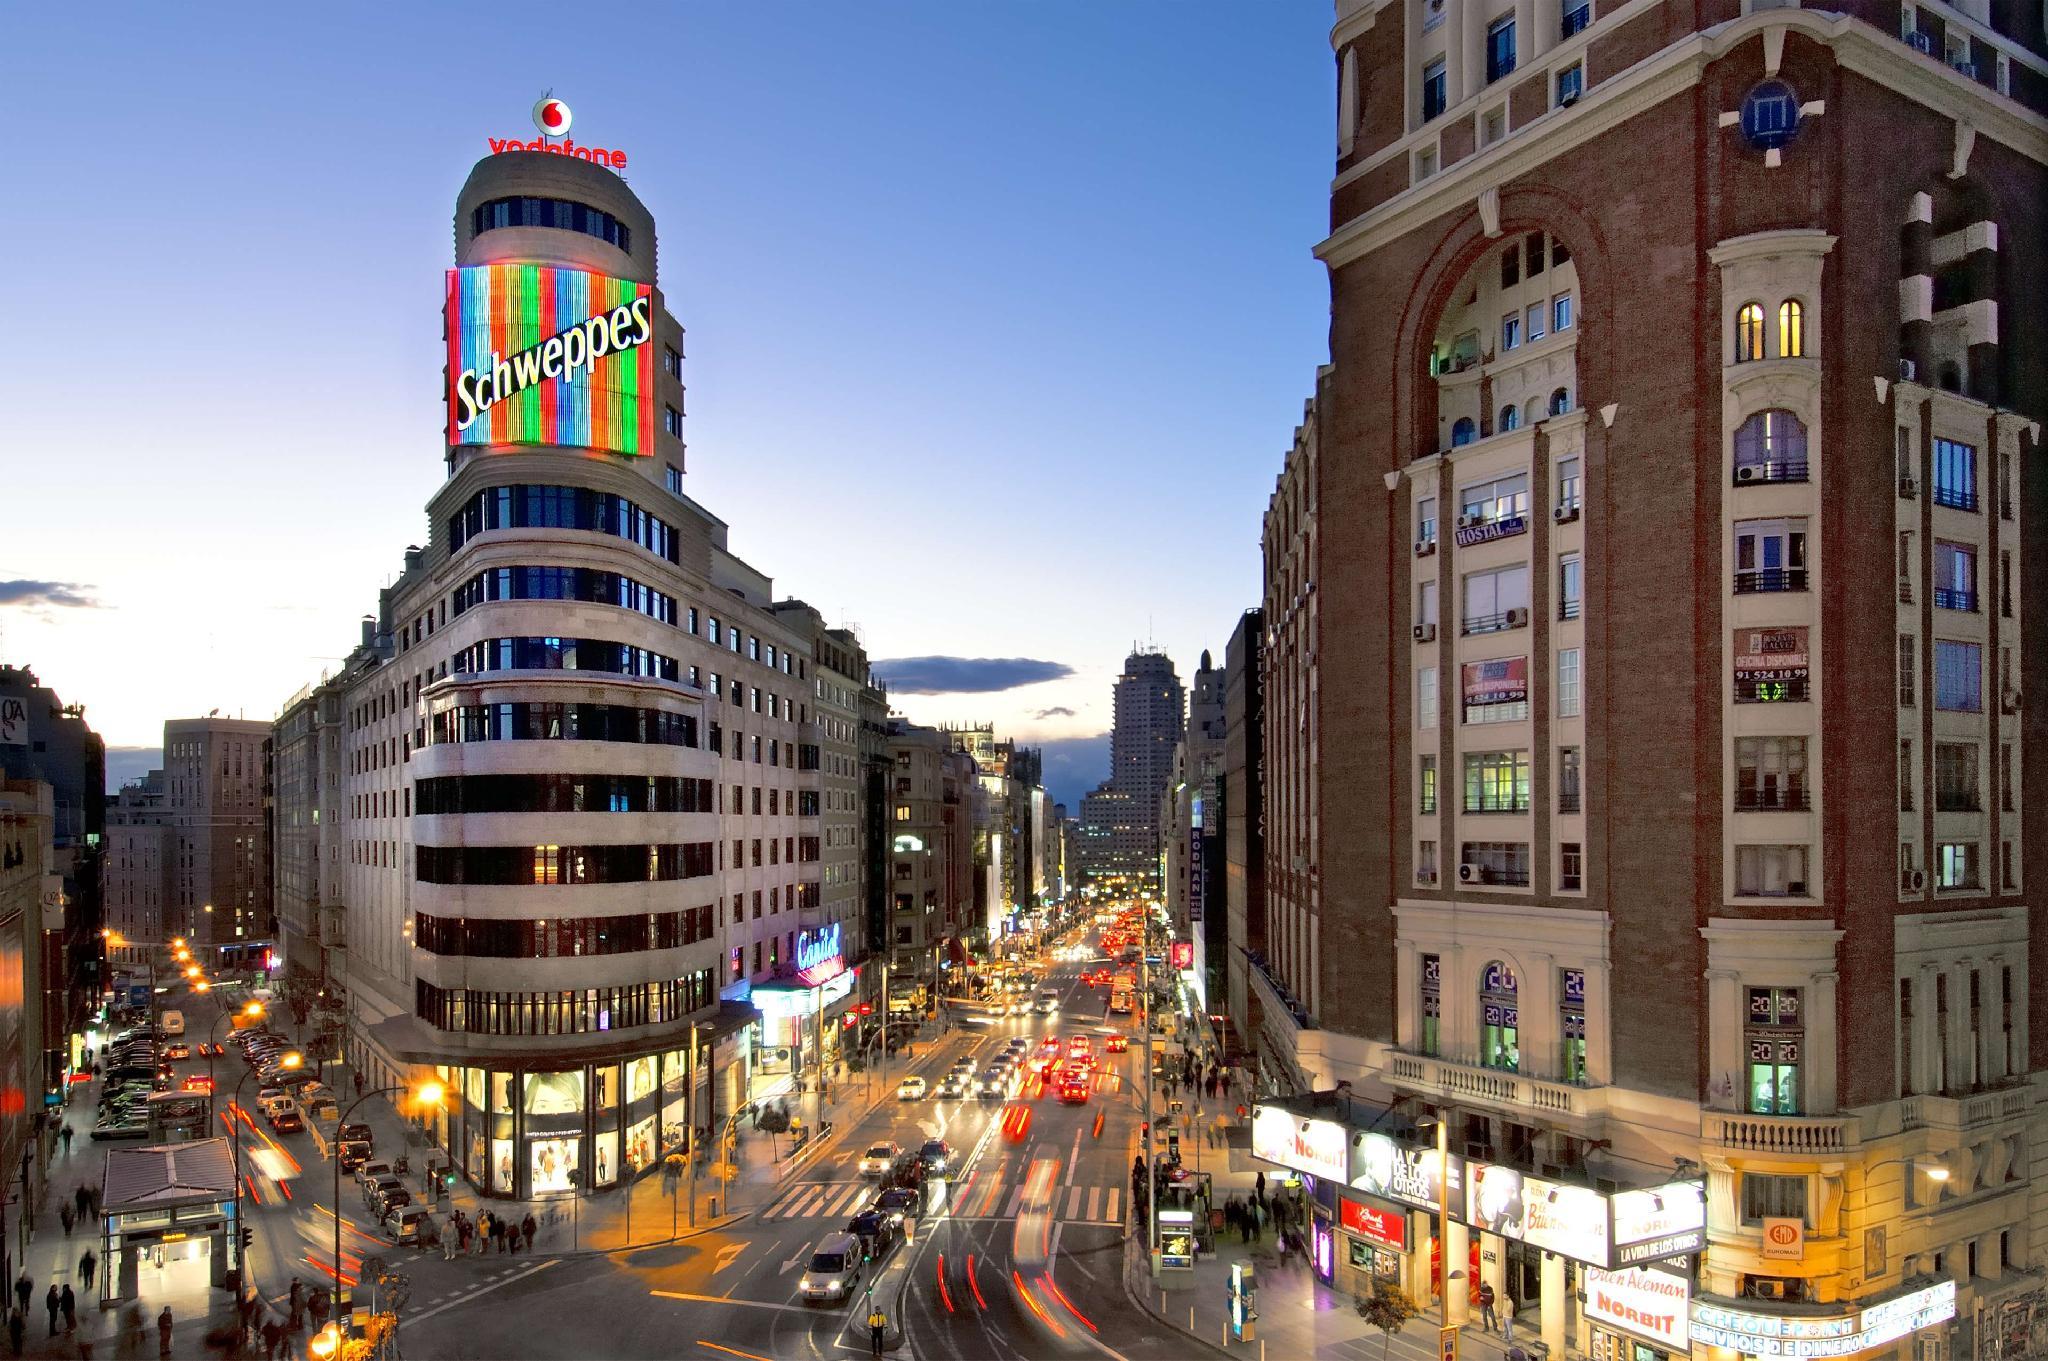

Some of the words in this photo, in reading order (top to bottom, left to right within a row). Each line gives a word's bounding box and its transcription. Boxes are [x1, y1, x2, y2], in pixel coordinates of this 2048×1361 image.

[488, 137, 627, 169] vodafone
[457, 297, 650, 431] Schweppes
[1457, 523, 1504, 545] HOSTAL
[1736, 670, 1749, 679] 91
[1754, 670, 1775, 680] 524
[1779, 670, 1791, 678] 10
[1794, 668, 1807, 677] 99
[1192, 831, 1201, 892] RODMAN
[1751, 996, 1770, 1012] 20
[1779, 997, 1797, 1012] 20
[1486, 1007, 1499, 1022] 20
[1505, 1010, 1517, 1025] 20
[1751, 1043, 1771, 1060] 20
[1779, 1044, 1797, 1061] 20
[1392, 1146, 1405, 1164] LA
[1393, 1163, 1408, 1180] DE
[1394, 1178, 1430, 1199] OTROS
[1620, 1250, 1631, 1263] LA
[1631, 1245, 1650, 1262] VIDA
[1650, 1243, 1660, 1256] DE
[1660, 1239, 1673, 1254] LOS
[1673, 1234, 1699, 1251] OTROS
[1589, 1266, 1625, 1287] Buen
[1597, 1290, 1675, 1335] NORBIT
[1691, 1323, 1765, 1353] ENVIOS
[1769, 1339, 1796, 1357] DE
[1800, 1335, 1860, 1357] DINERO
